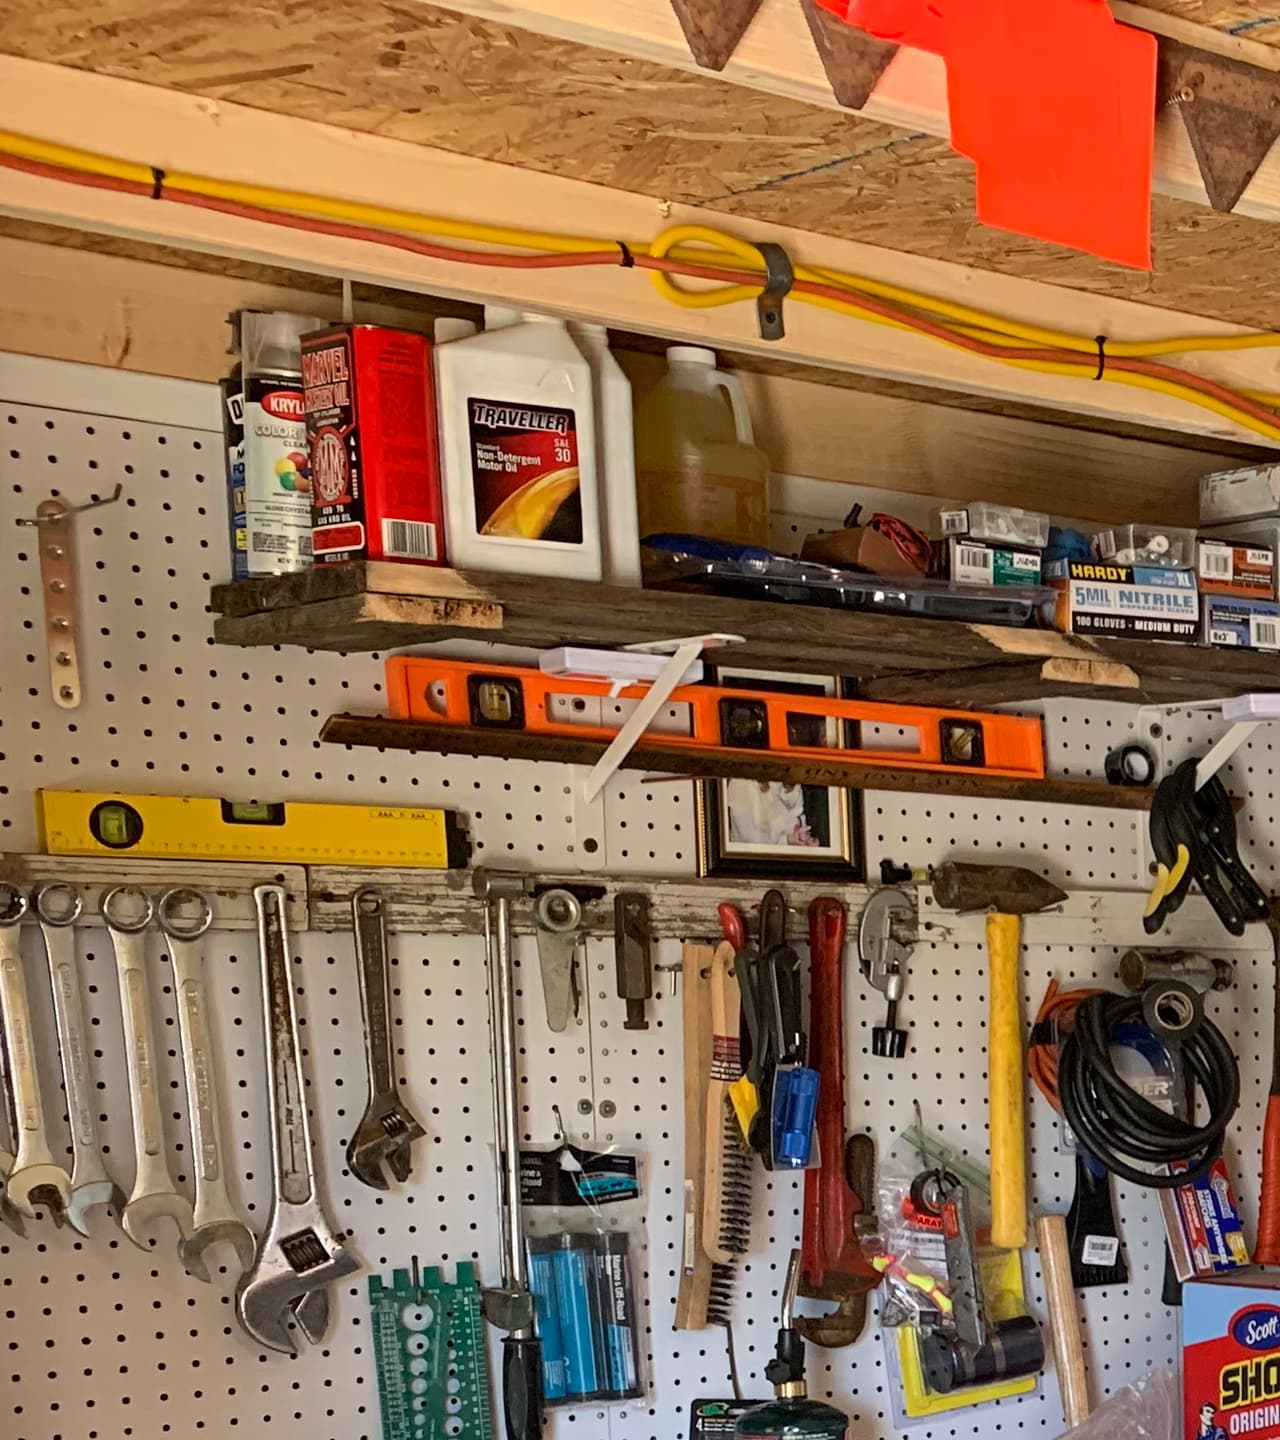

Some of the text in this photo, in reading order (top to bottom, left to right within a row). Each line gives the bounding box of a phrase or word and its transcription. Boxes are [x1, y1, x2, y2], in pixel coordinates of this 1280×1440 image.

[302, 347, 348, 388] MARVEL
[474, 403, 568, 435] TRAVELLER
[255, 425, 297, 438] COLOR
[477, 450, 541, 466] Non-Detergent
[554, 449, 571, 463] 30
[478, 460, 517, 472] Motor Oil
[1072, 563, 1128, 581] HARDY
[1176, 573, 1192, 587] XL
[1119, 590, 1193, 608] NITRILE
[1076, 616, 1195, 634] 100 GLOVES MEDIUM DUTY
[1246, 1315, 1279, 1344] Scott
